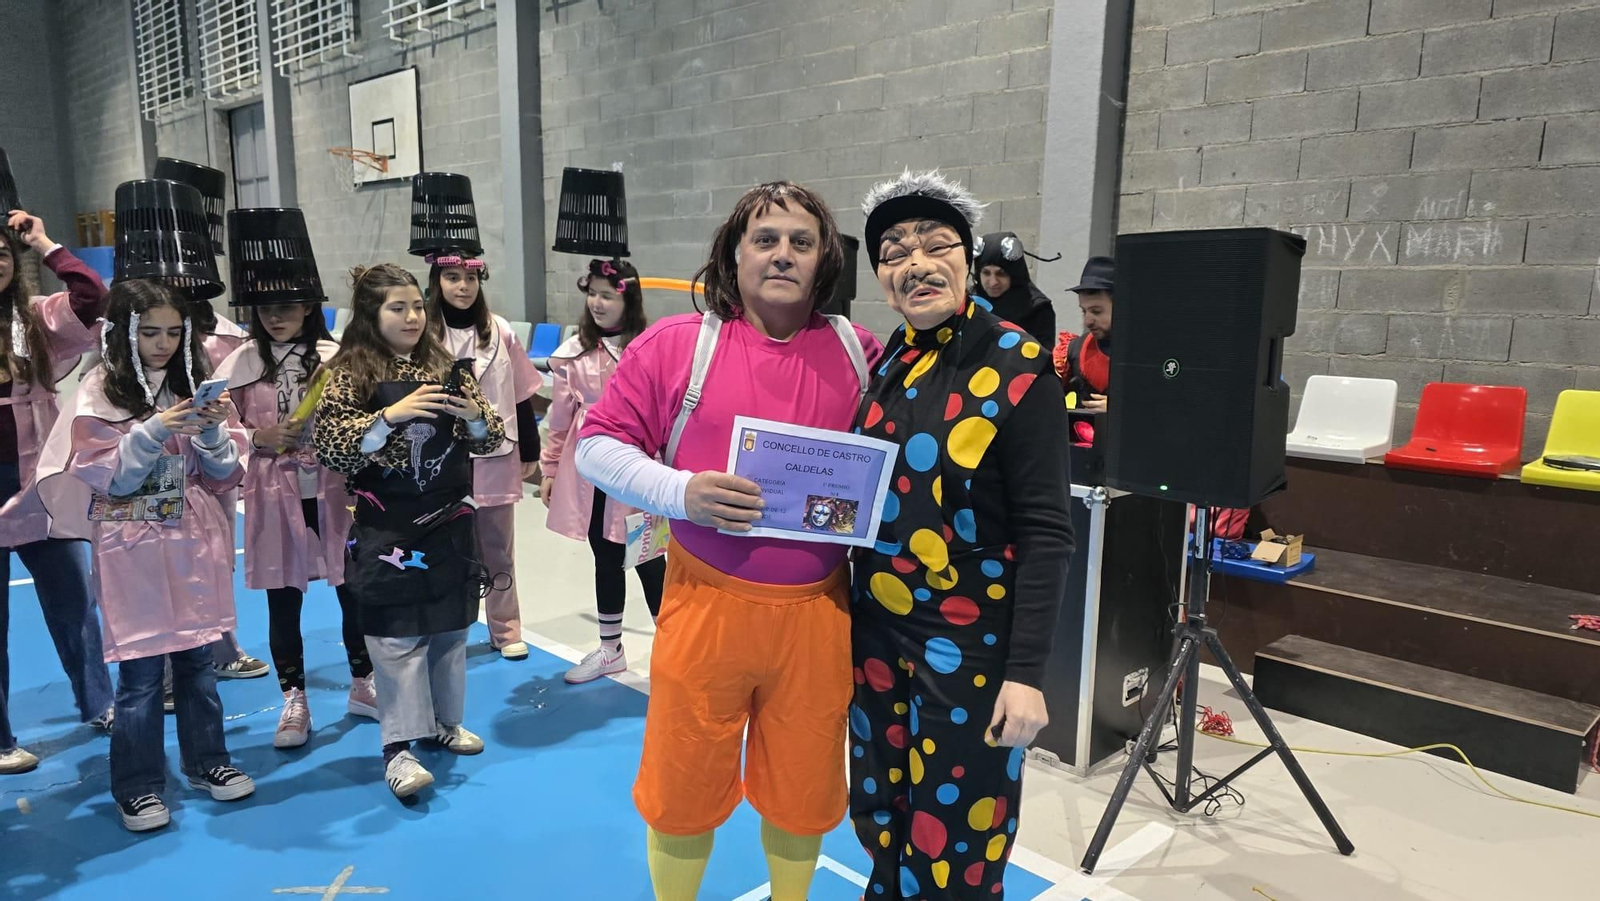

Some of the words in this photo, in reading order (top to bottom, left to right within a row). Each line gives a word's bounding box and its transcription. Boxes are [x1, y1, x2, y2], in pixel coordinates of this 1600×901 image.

[762, 440, 815, 456] CONCELLO
[817, 448, 831, 458] DE
[832, 450, 872, 464] CASTRO
[785, 463, 834, 476] CALDELAS
